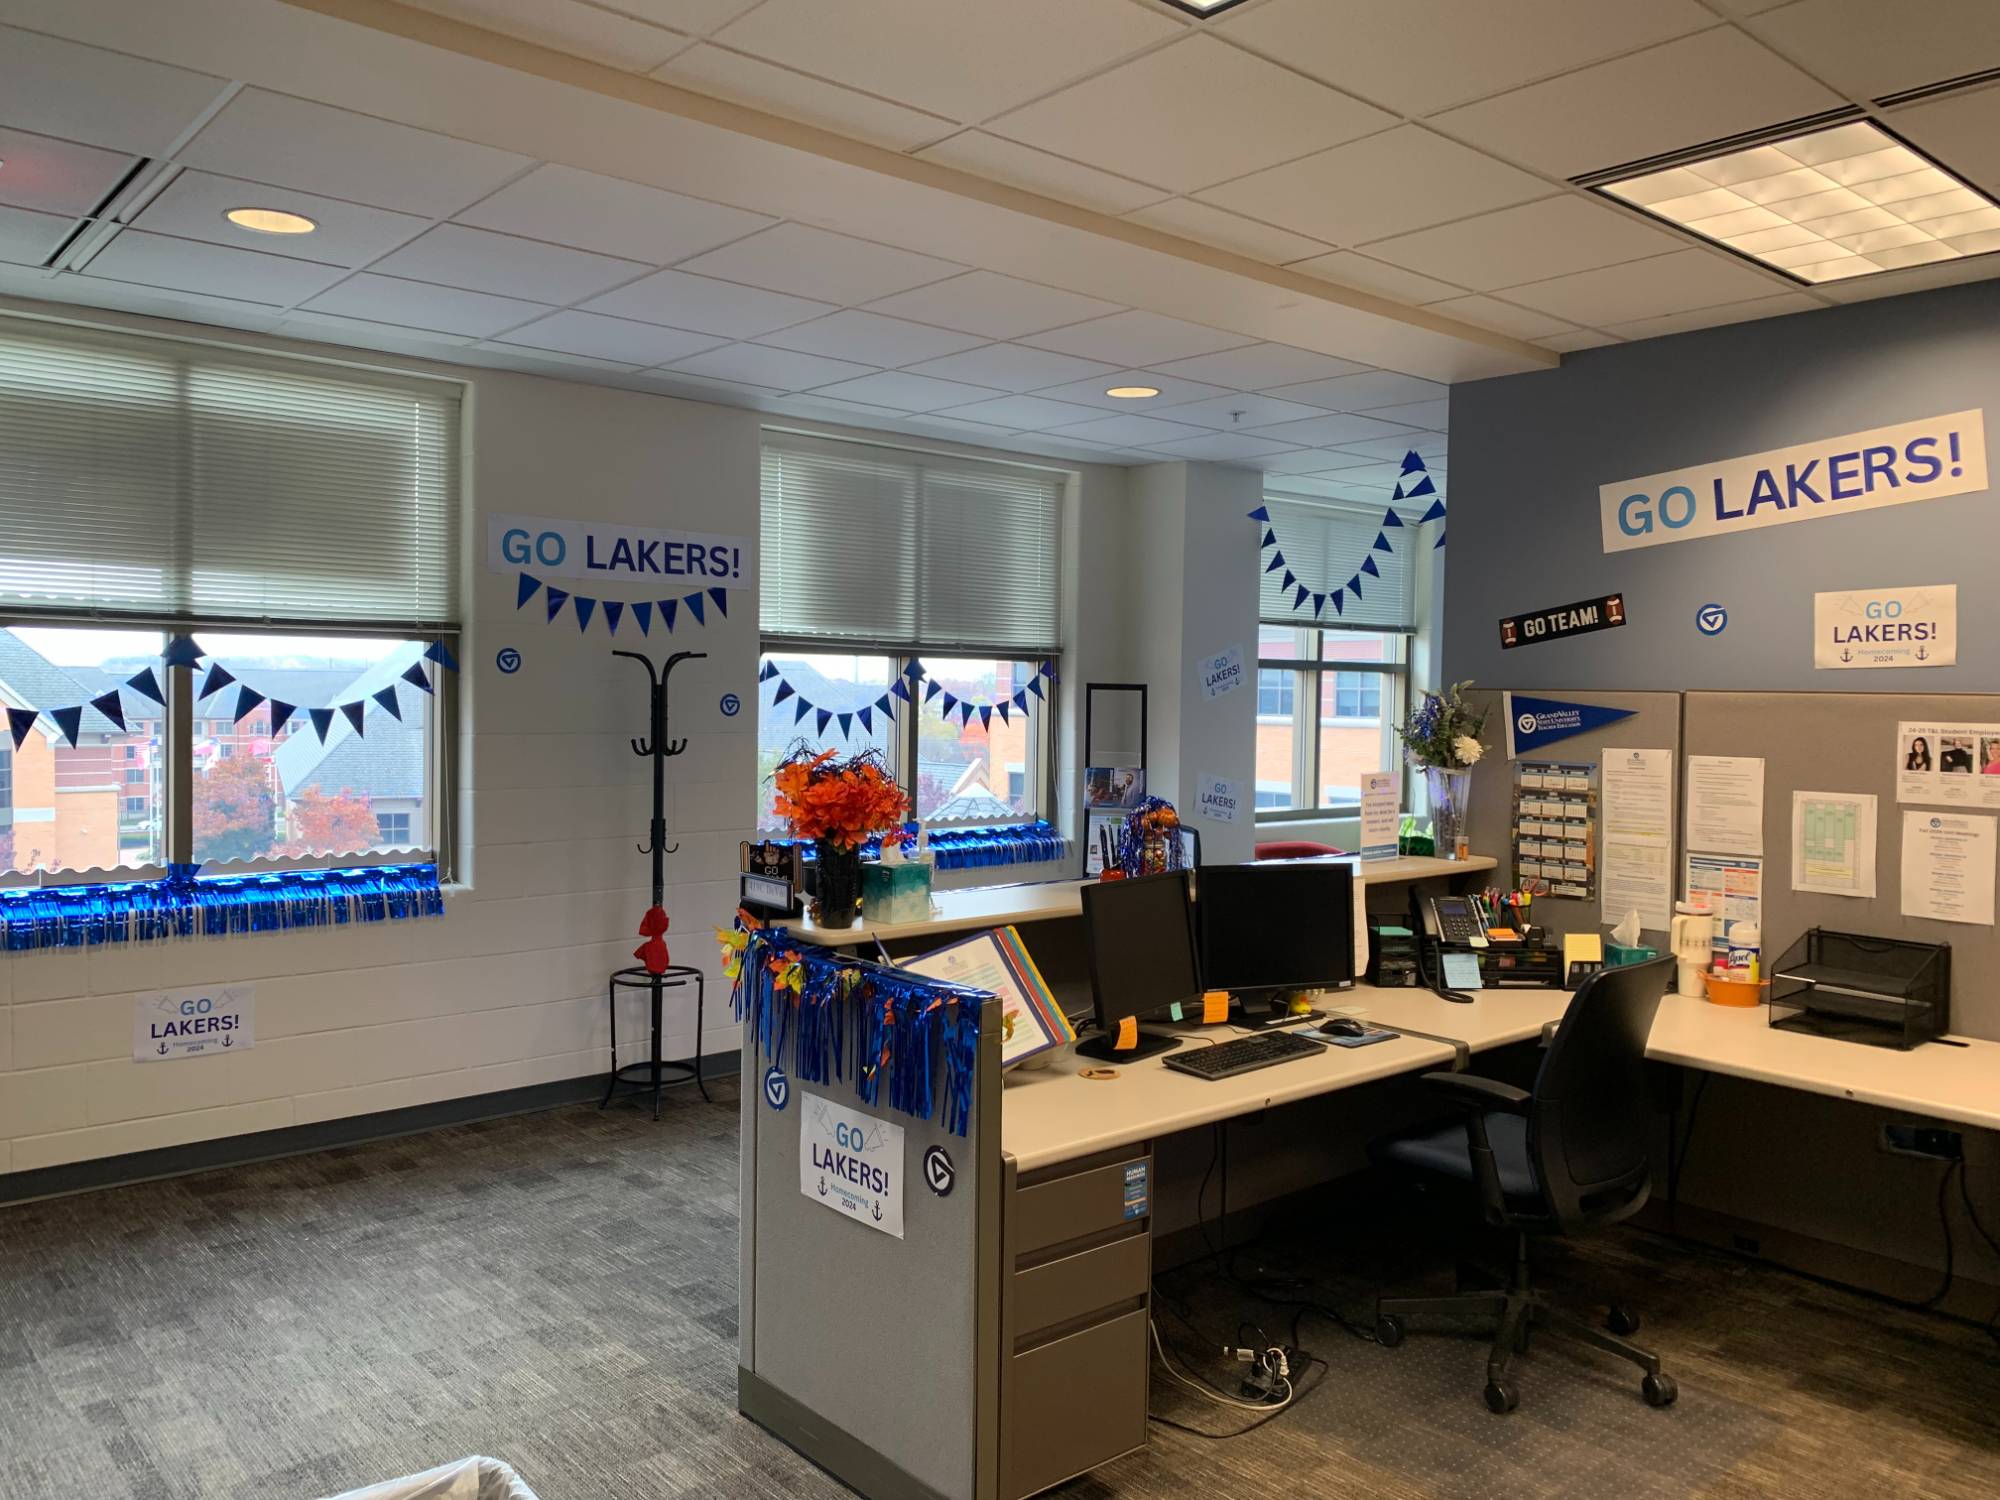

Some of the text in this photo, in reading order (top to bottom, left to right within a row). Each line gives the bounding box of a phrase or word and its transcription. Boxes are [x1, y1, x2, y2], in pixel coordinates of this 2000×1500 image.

[1618, 432, 1963, 536] GO LAKERS!
[502, 528, 740, 579] GO LAKERS!
[1866, 600, 1902, 619] GO
[1524, 606, 1599, 637] GO TEAM!
[1834, 622, 1936, 643] LAKERS!
[1857, 647, 1910, 656] Homecoming
[1215, 656, 1227, 669] GO
[1206, 663, 1240, 687] LAKERS!
[1215, 783, 1226, 793] GO
[1201, 792, 1236, 810] LAKERS!
[764, 866, 778, 875] GO
[180, 998, 212, 1015] GO
[151, 1014, 239, 1039] LAKERS!
[836, 1122, 864, 1152] GO
[812, 1143, 889, 1196] LAKERS!
[830, 1182, 869, 1209] Homecoming
[841, 1197, 857, 1211] 2024
